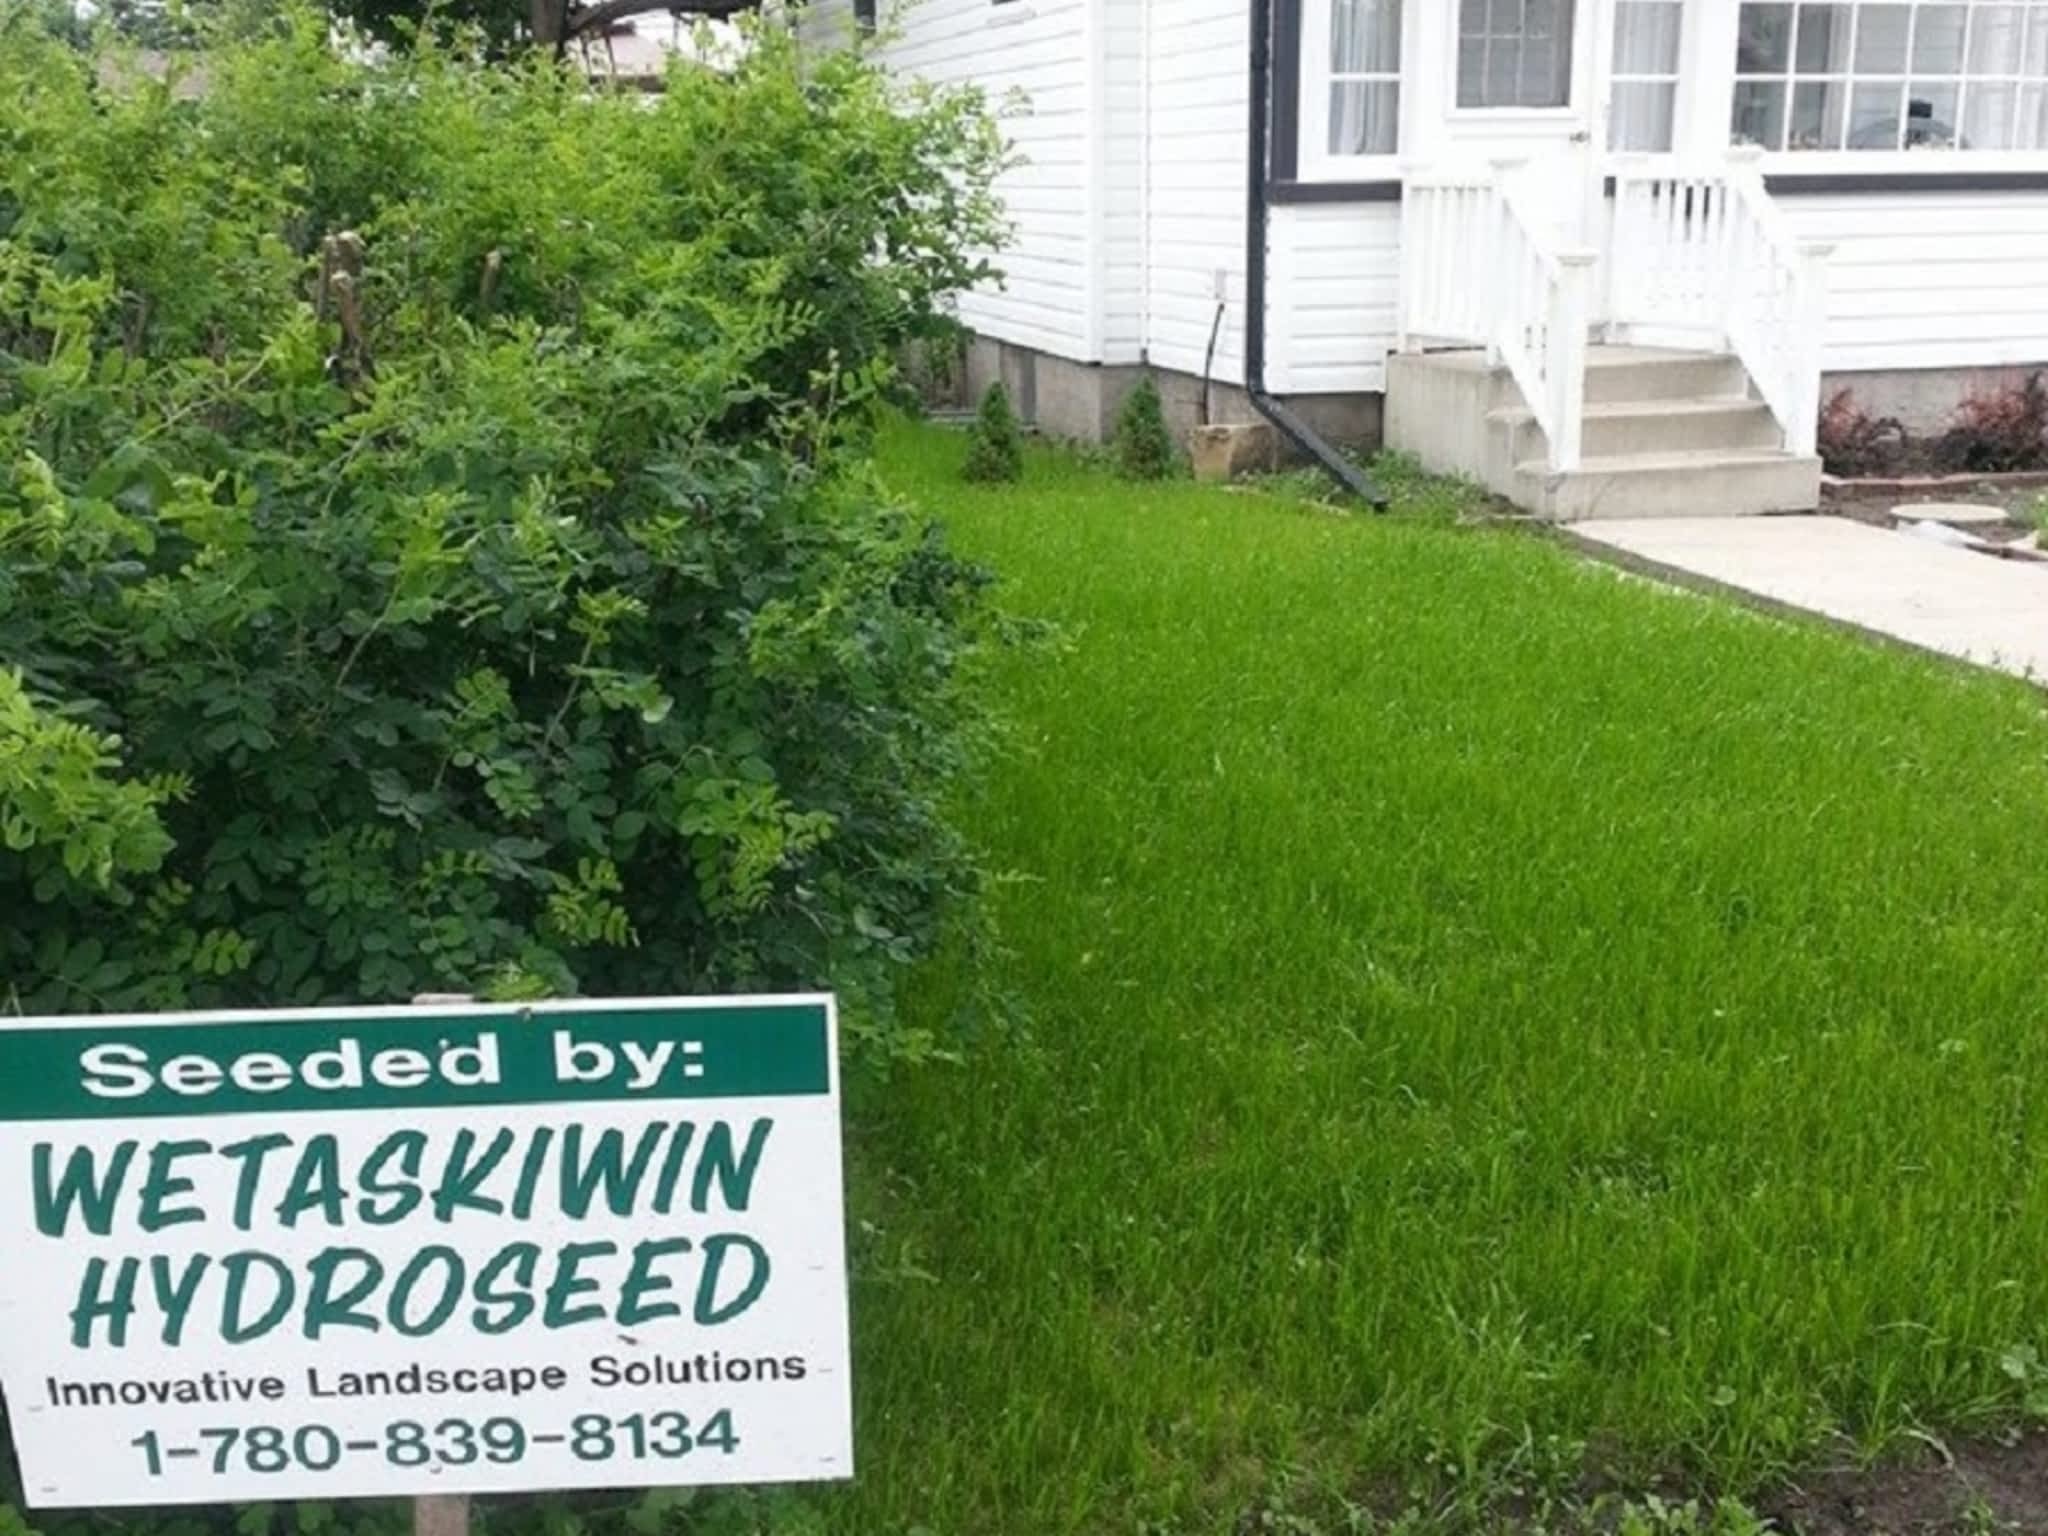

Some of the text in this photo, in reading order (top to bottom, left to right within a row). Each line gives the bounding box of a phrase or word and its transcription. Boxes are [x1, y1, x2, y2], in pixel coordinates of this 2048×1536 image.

[80, 1031, 704, 1095] Seeded by:
[32, 1119, 774, 1238] WETASKIWIN
[70, 1234, 771, 1347] HYDROSEED
[47, 1353, 807, 1406] Innovative Landscape Solutions
[131, 1409, 741, 1476] 1-780-839-8134
